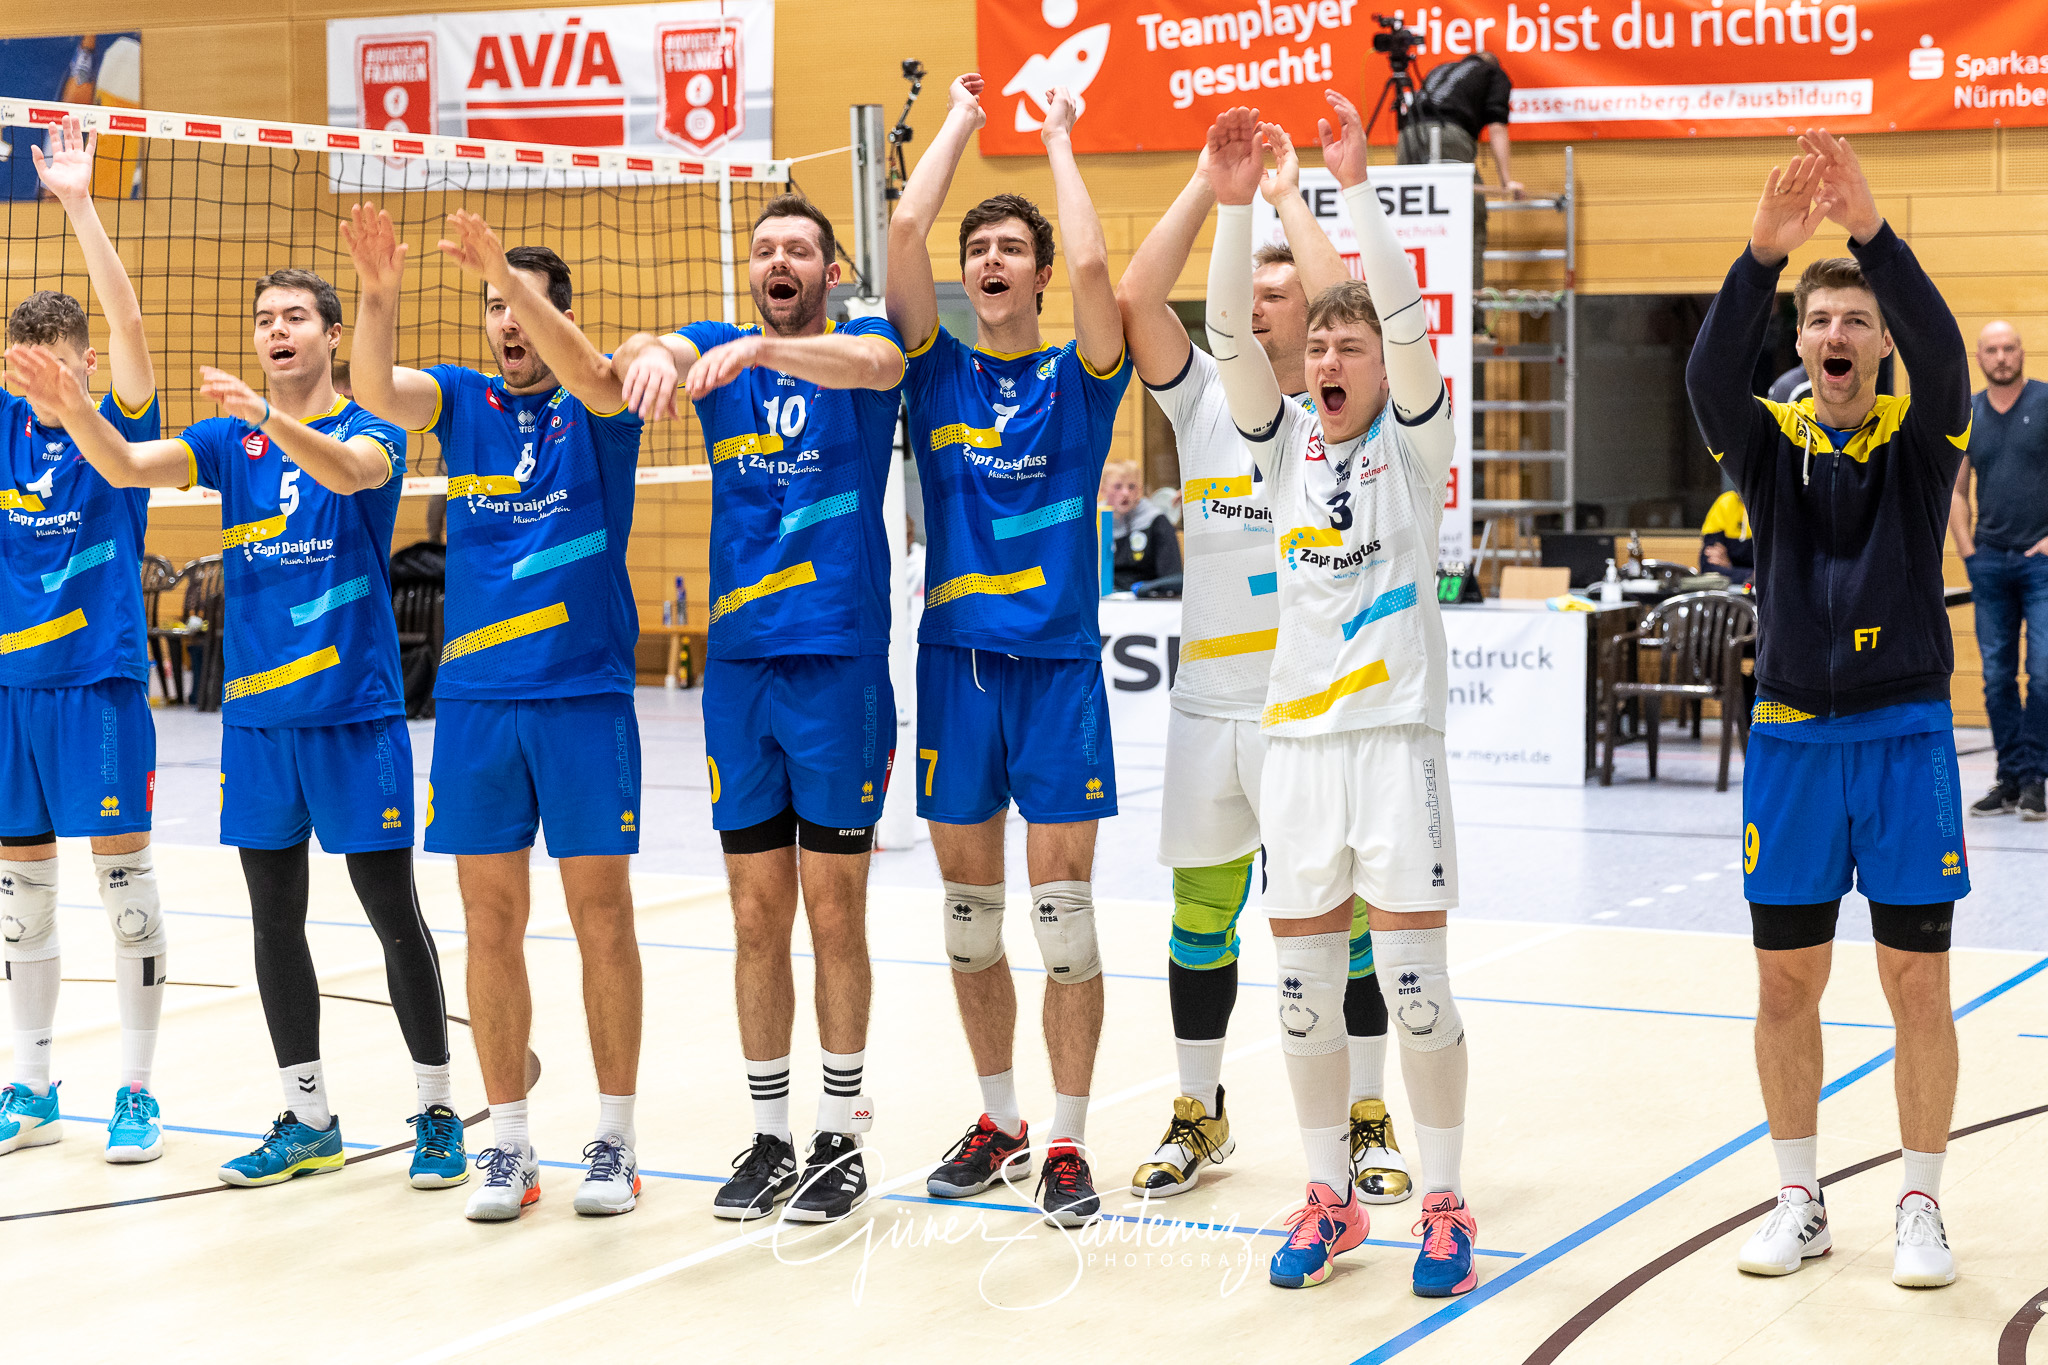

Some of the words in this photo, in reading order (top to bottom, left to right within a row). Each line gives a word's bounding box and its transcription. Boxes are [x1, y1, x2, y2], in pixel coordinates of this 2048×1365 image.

[1136, 0, 1358, 51] Teamplayer
[1505, 3, 1600, 53] bist
[1611, 0, 1675, 50] du
[1690, 0, 1875, 55] richtig.
[1169, 42, 1334, 110] gesucht!
[1954, 49, 2048, 83] Sparkas
[1507, 85, 1863, 115] kasse-nuernberg.de/ausbildung
[1954, 81, 2048, 109] Nürnbe
[763, 394, 807, 437] 10
[992, 402, 1021, 433] 7
[279, 467, 301, 518] 5
[476, 494, 511, 514] Zapf
[1211, 499, 1243, 519] Zapf
[1326, 489, 1354, 531] 3
[252, 541, 281, 558] Zapf
[1853, 626, 1882, 652] FT
[1450, 644, 1554, 671] tdruck
[1448, 680, 1494, 705] nik
[919, 747, 939, 797] 7
[1743, 822, 1761, 875] 9
